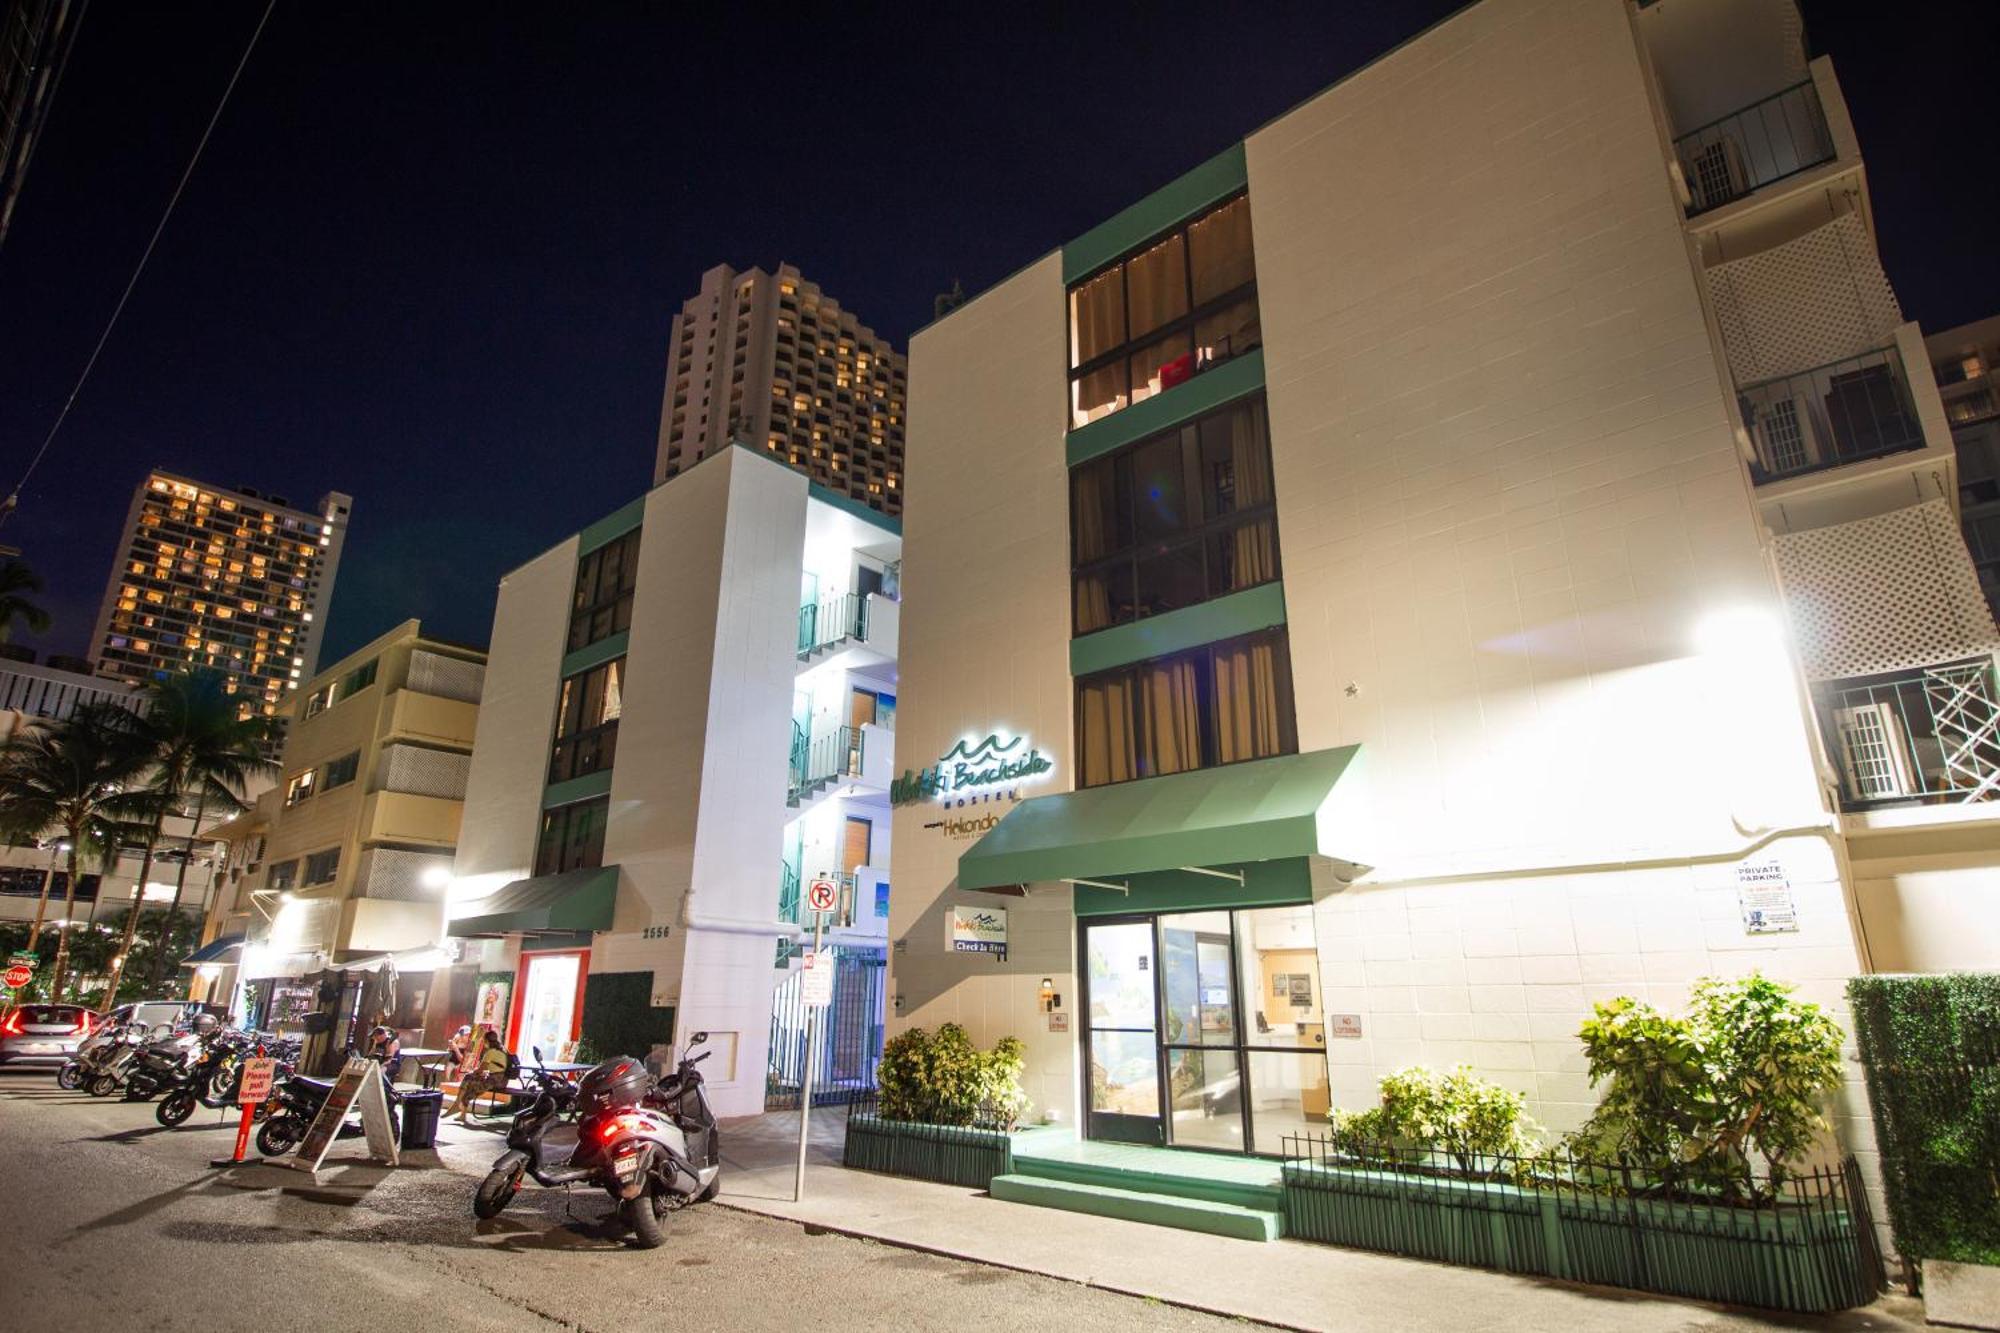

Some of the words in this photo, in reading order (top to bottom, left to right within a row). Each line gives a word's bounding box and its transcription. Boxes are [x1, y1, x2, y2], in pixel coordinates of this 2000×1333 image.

[952, 750, 1052, 790] Beachside
[944, 790, 1014, 810] HOSTEL
[1738, 866, 1781, 874] PRIVATE
[1740, 874, 1783, 882] PARKING
[7, 971, 29, 981] STOP
[246, 1071, 271, 1080] Please
